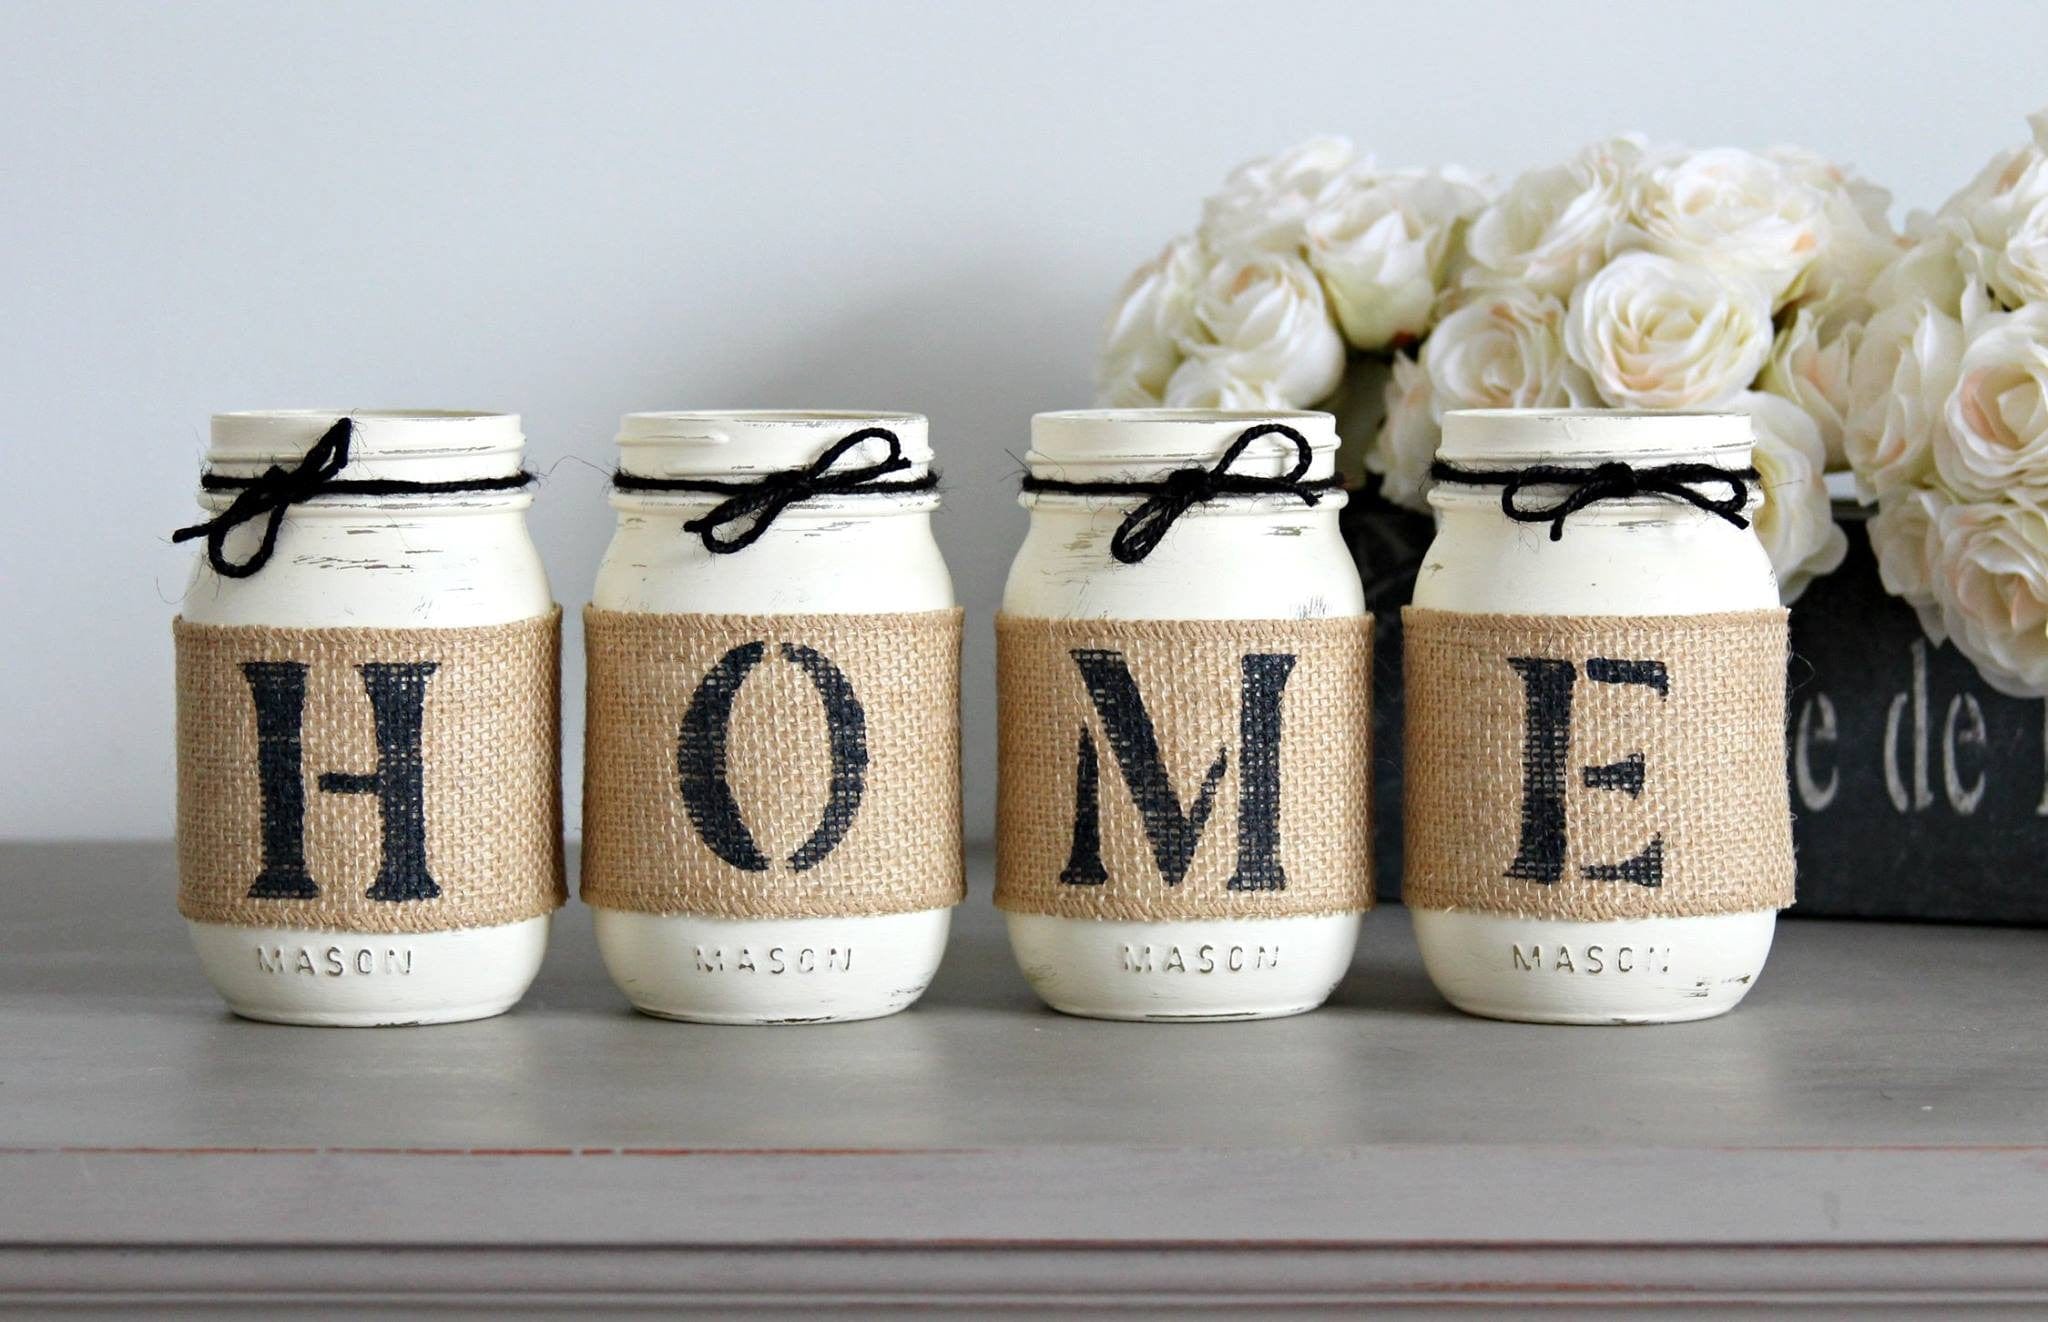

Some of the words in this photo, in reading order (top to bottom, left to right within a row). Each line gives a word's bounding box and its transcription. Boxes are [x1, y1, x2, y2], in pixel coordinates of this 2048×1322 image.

[238, 660, 442, 902] H
[677, 640, 870, 874] O
[1060, 648, 1297, 893] M
[1504, 655, 1672, 888] E
[1885, 637, 1987, 815] de
[256, 945, 413, 977] MASON
[696, 946, 853, 975] MASON
[1120, 944, 1280, 974] MASON
[1512, 943, 1671, 974] MASON
